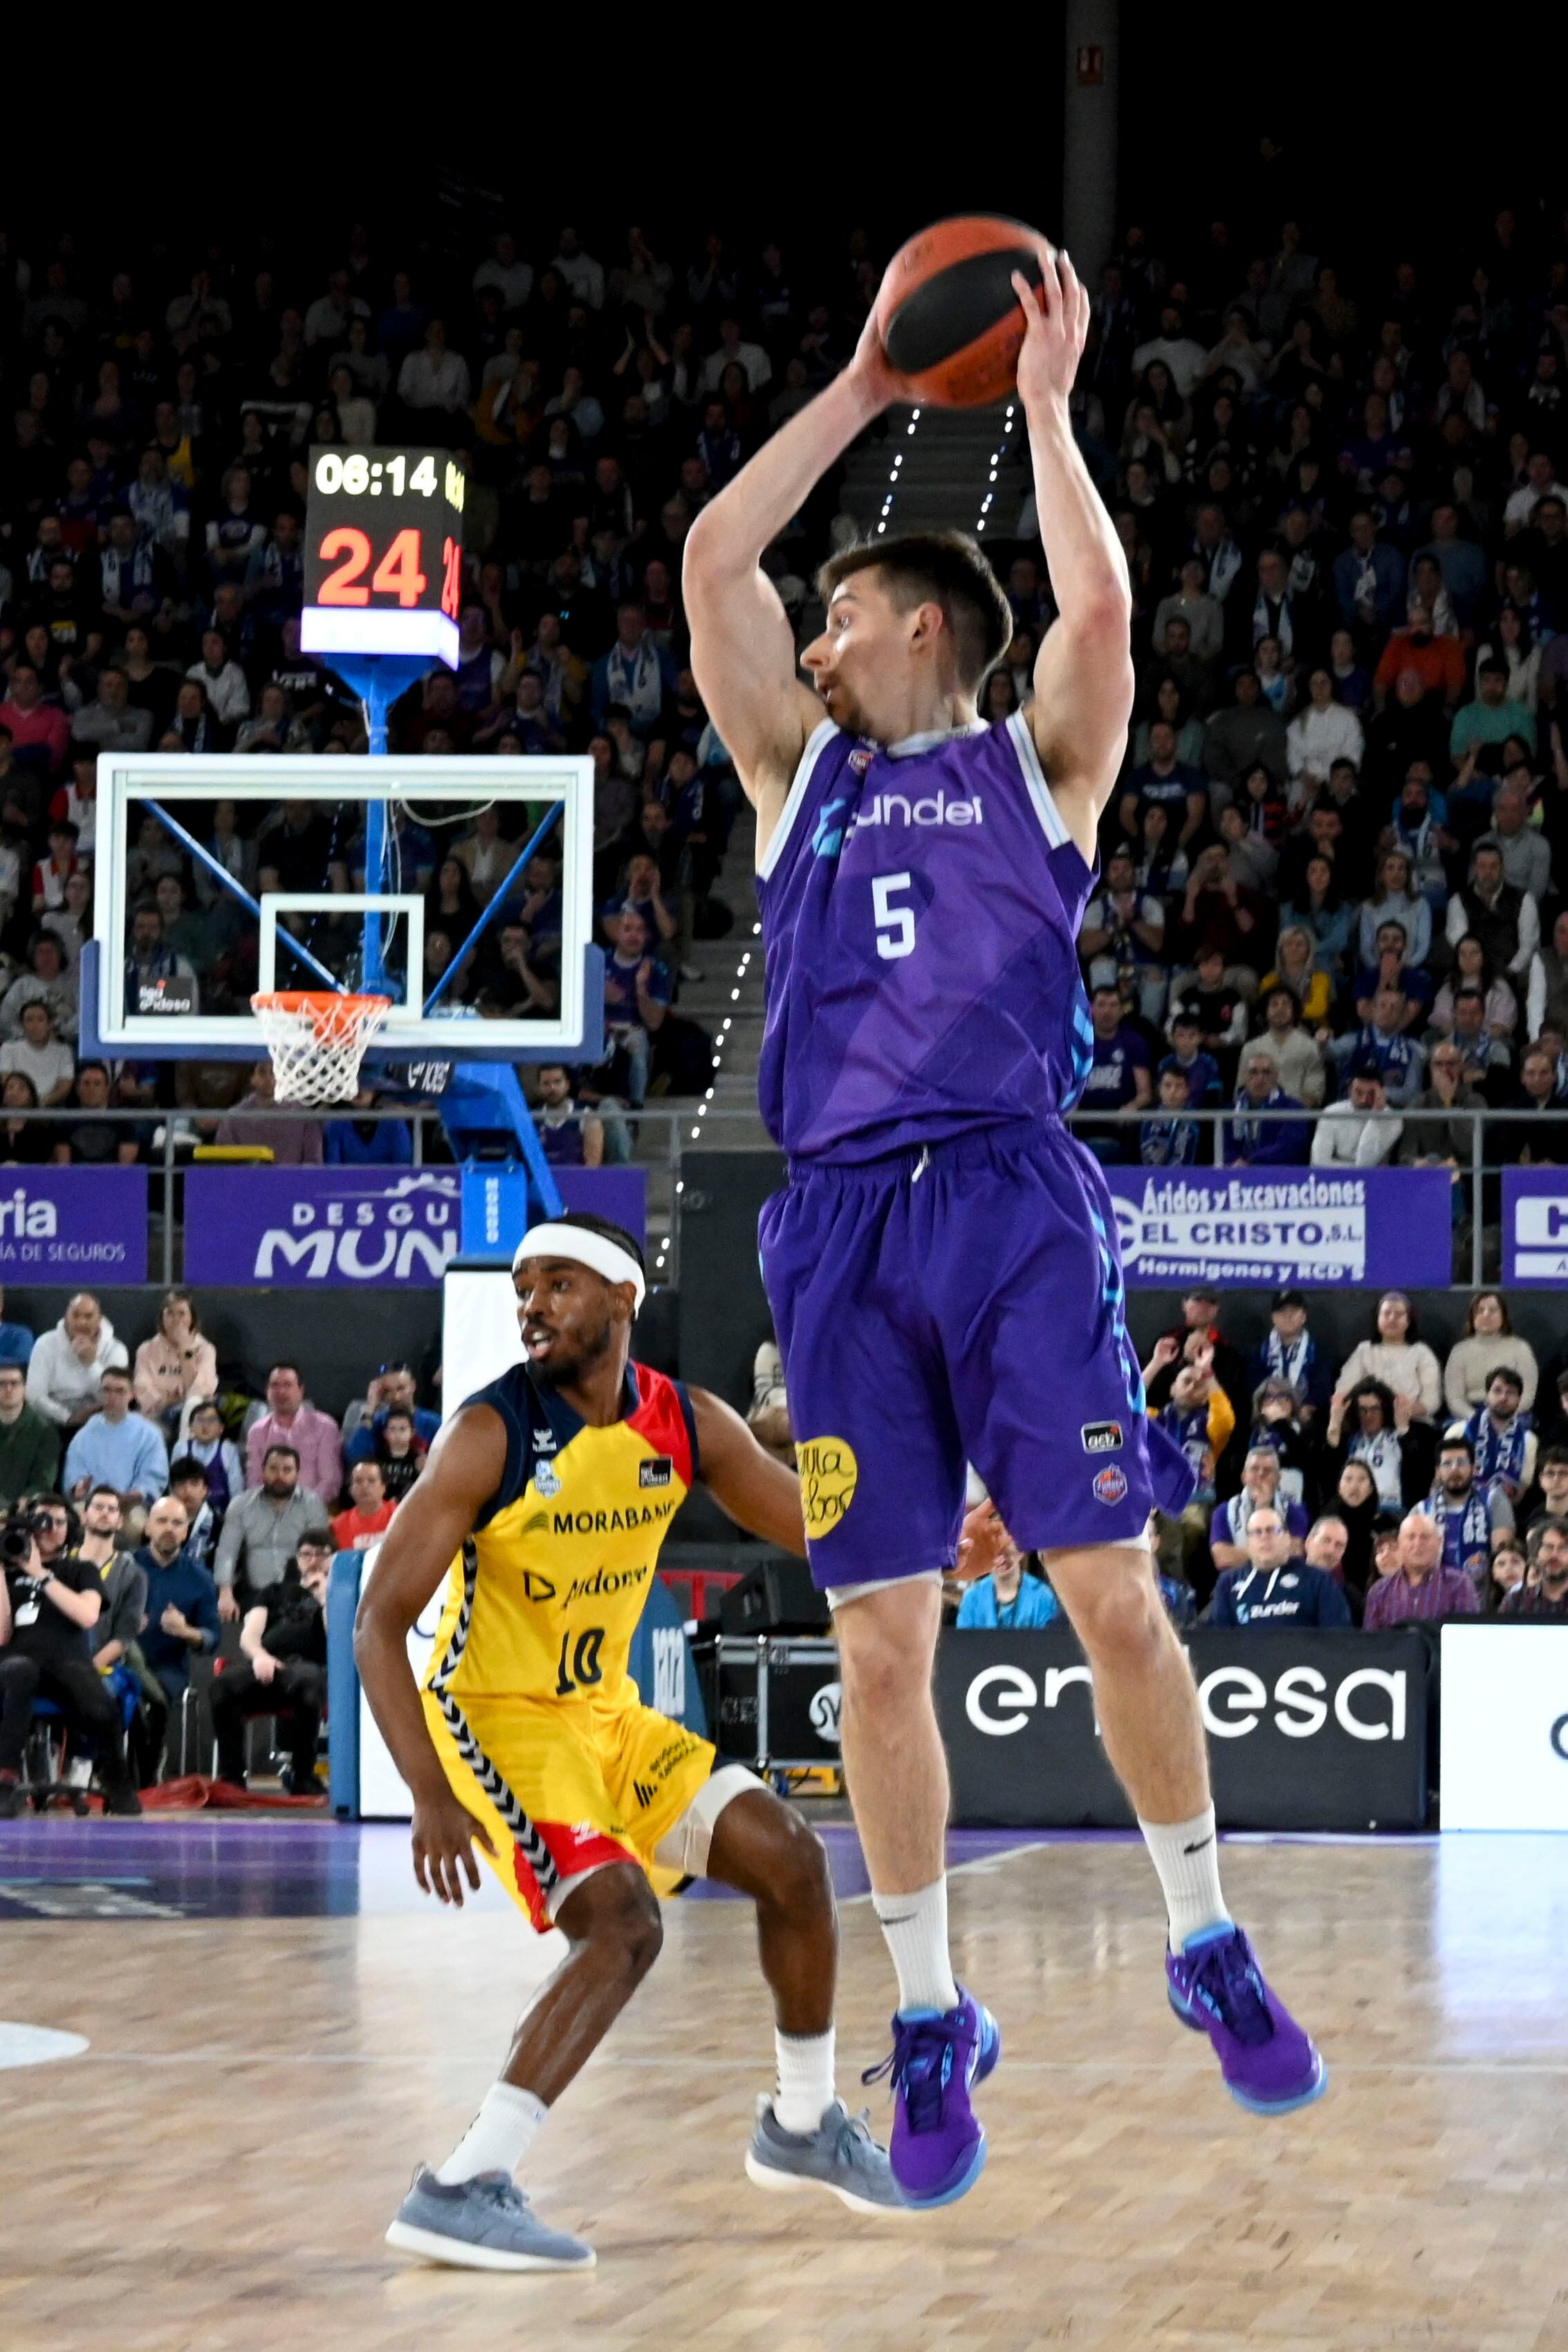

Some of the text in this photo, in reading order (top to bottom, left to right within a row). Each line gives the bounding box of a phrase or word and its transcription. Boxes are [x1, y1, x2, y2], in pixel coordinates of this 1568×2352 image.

[315, 453, 438, 497] 06:14
[316, 527, 427, 607] 24
[871, 872, 916, 960] 5
[292, 1202, 450, 1226] DESGU
[1141, 1222, 1177, 1244] EL
[253, 1229, 458, 1278] MUN
[555, 1628, 606, 1696] 10
[966, 1645, 1407, 1740] enesa
